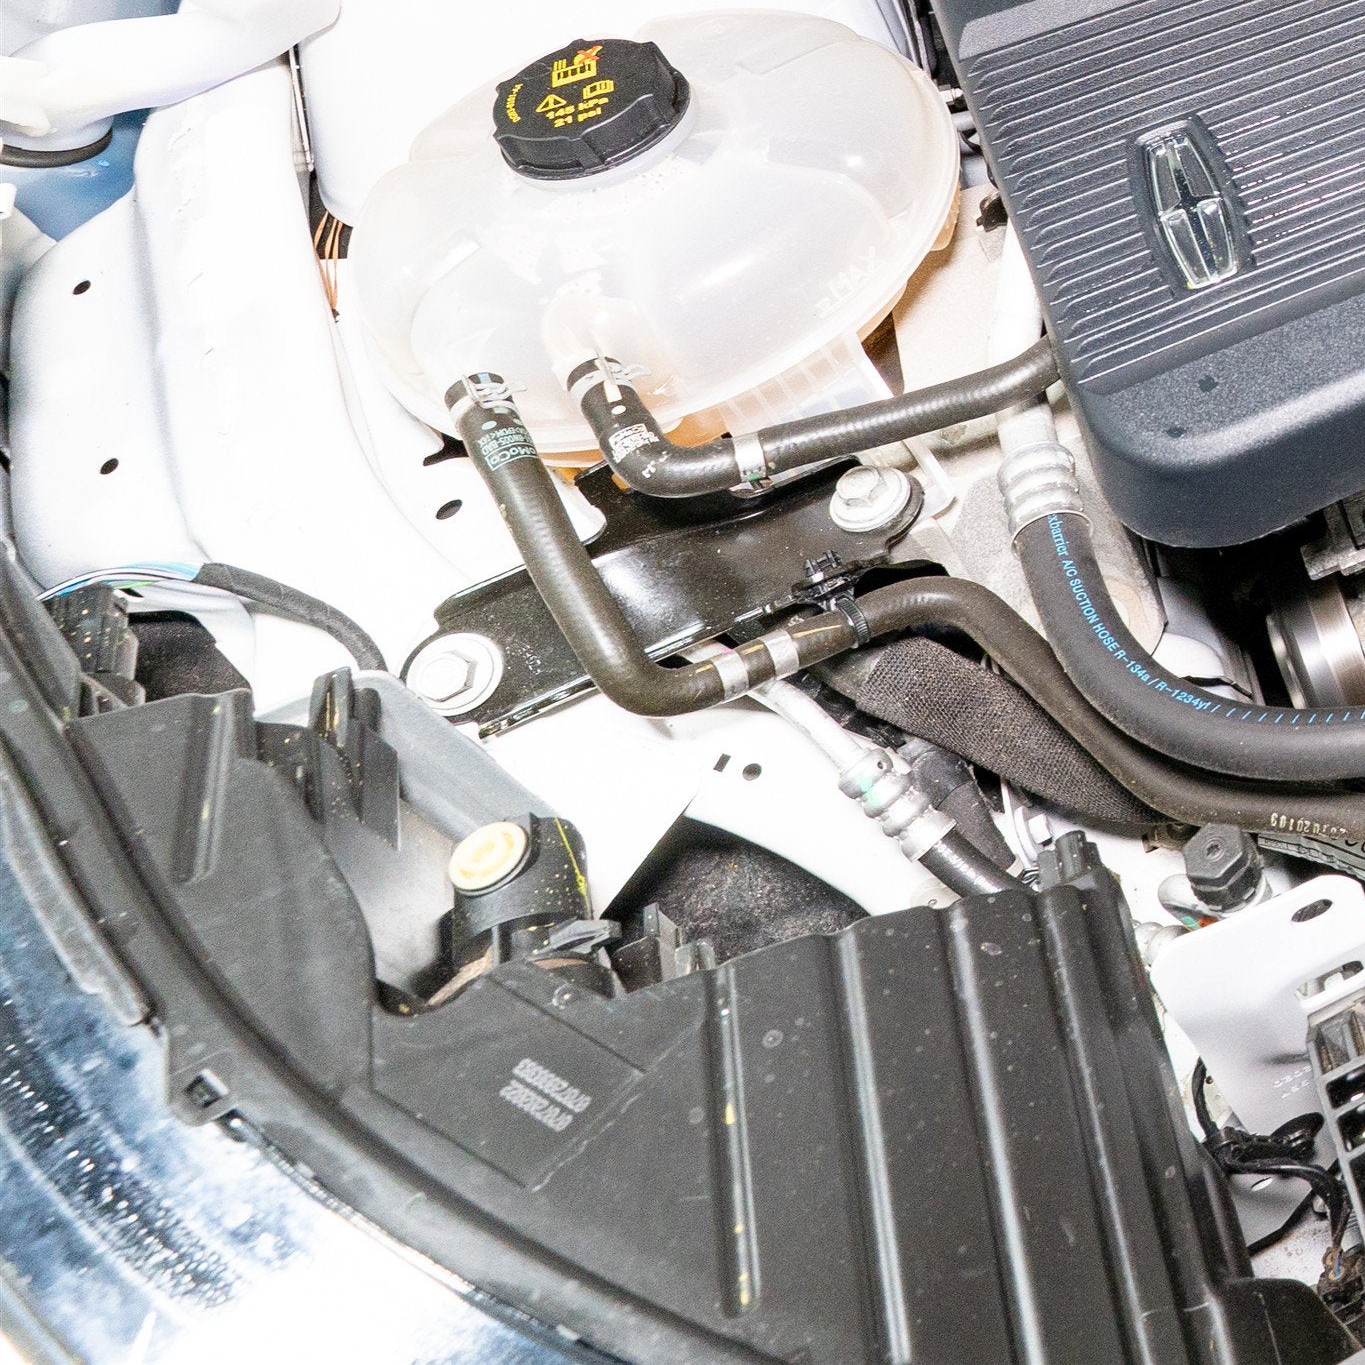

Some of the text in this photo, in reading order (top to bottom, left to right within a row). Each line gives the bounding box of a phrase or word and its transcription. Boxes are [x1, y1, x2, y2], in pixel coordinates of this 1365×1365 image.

[1062, 559, 1078, 578] A/C
[1069, 578, 1100, 626] SUCTION
[1092, 619, 1120, 653] HOSE
[1114, 649, 1150, 681] R-134a
[1154, 681, 1211, 711] R-1234yf
